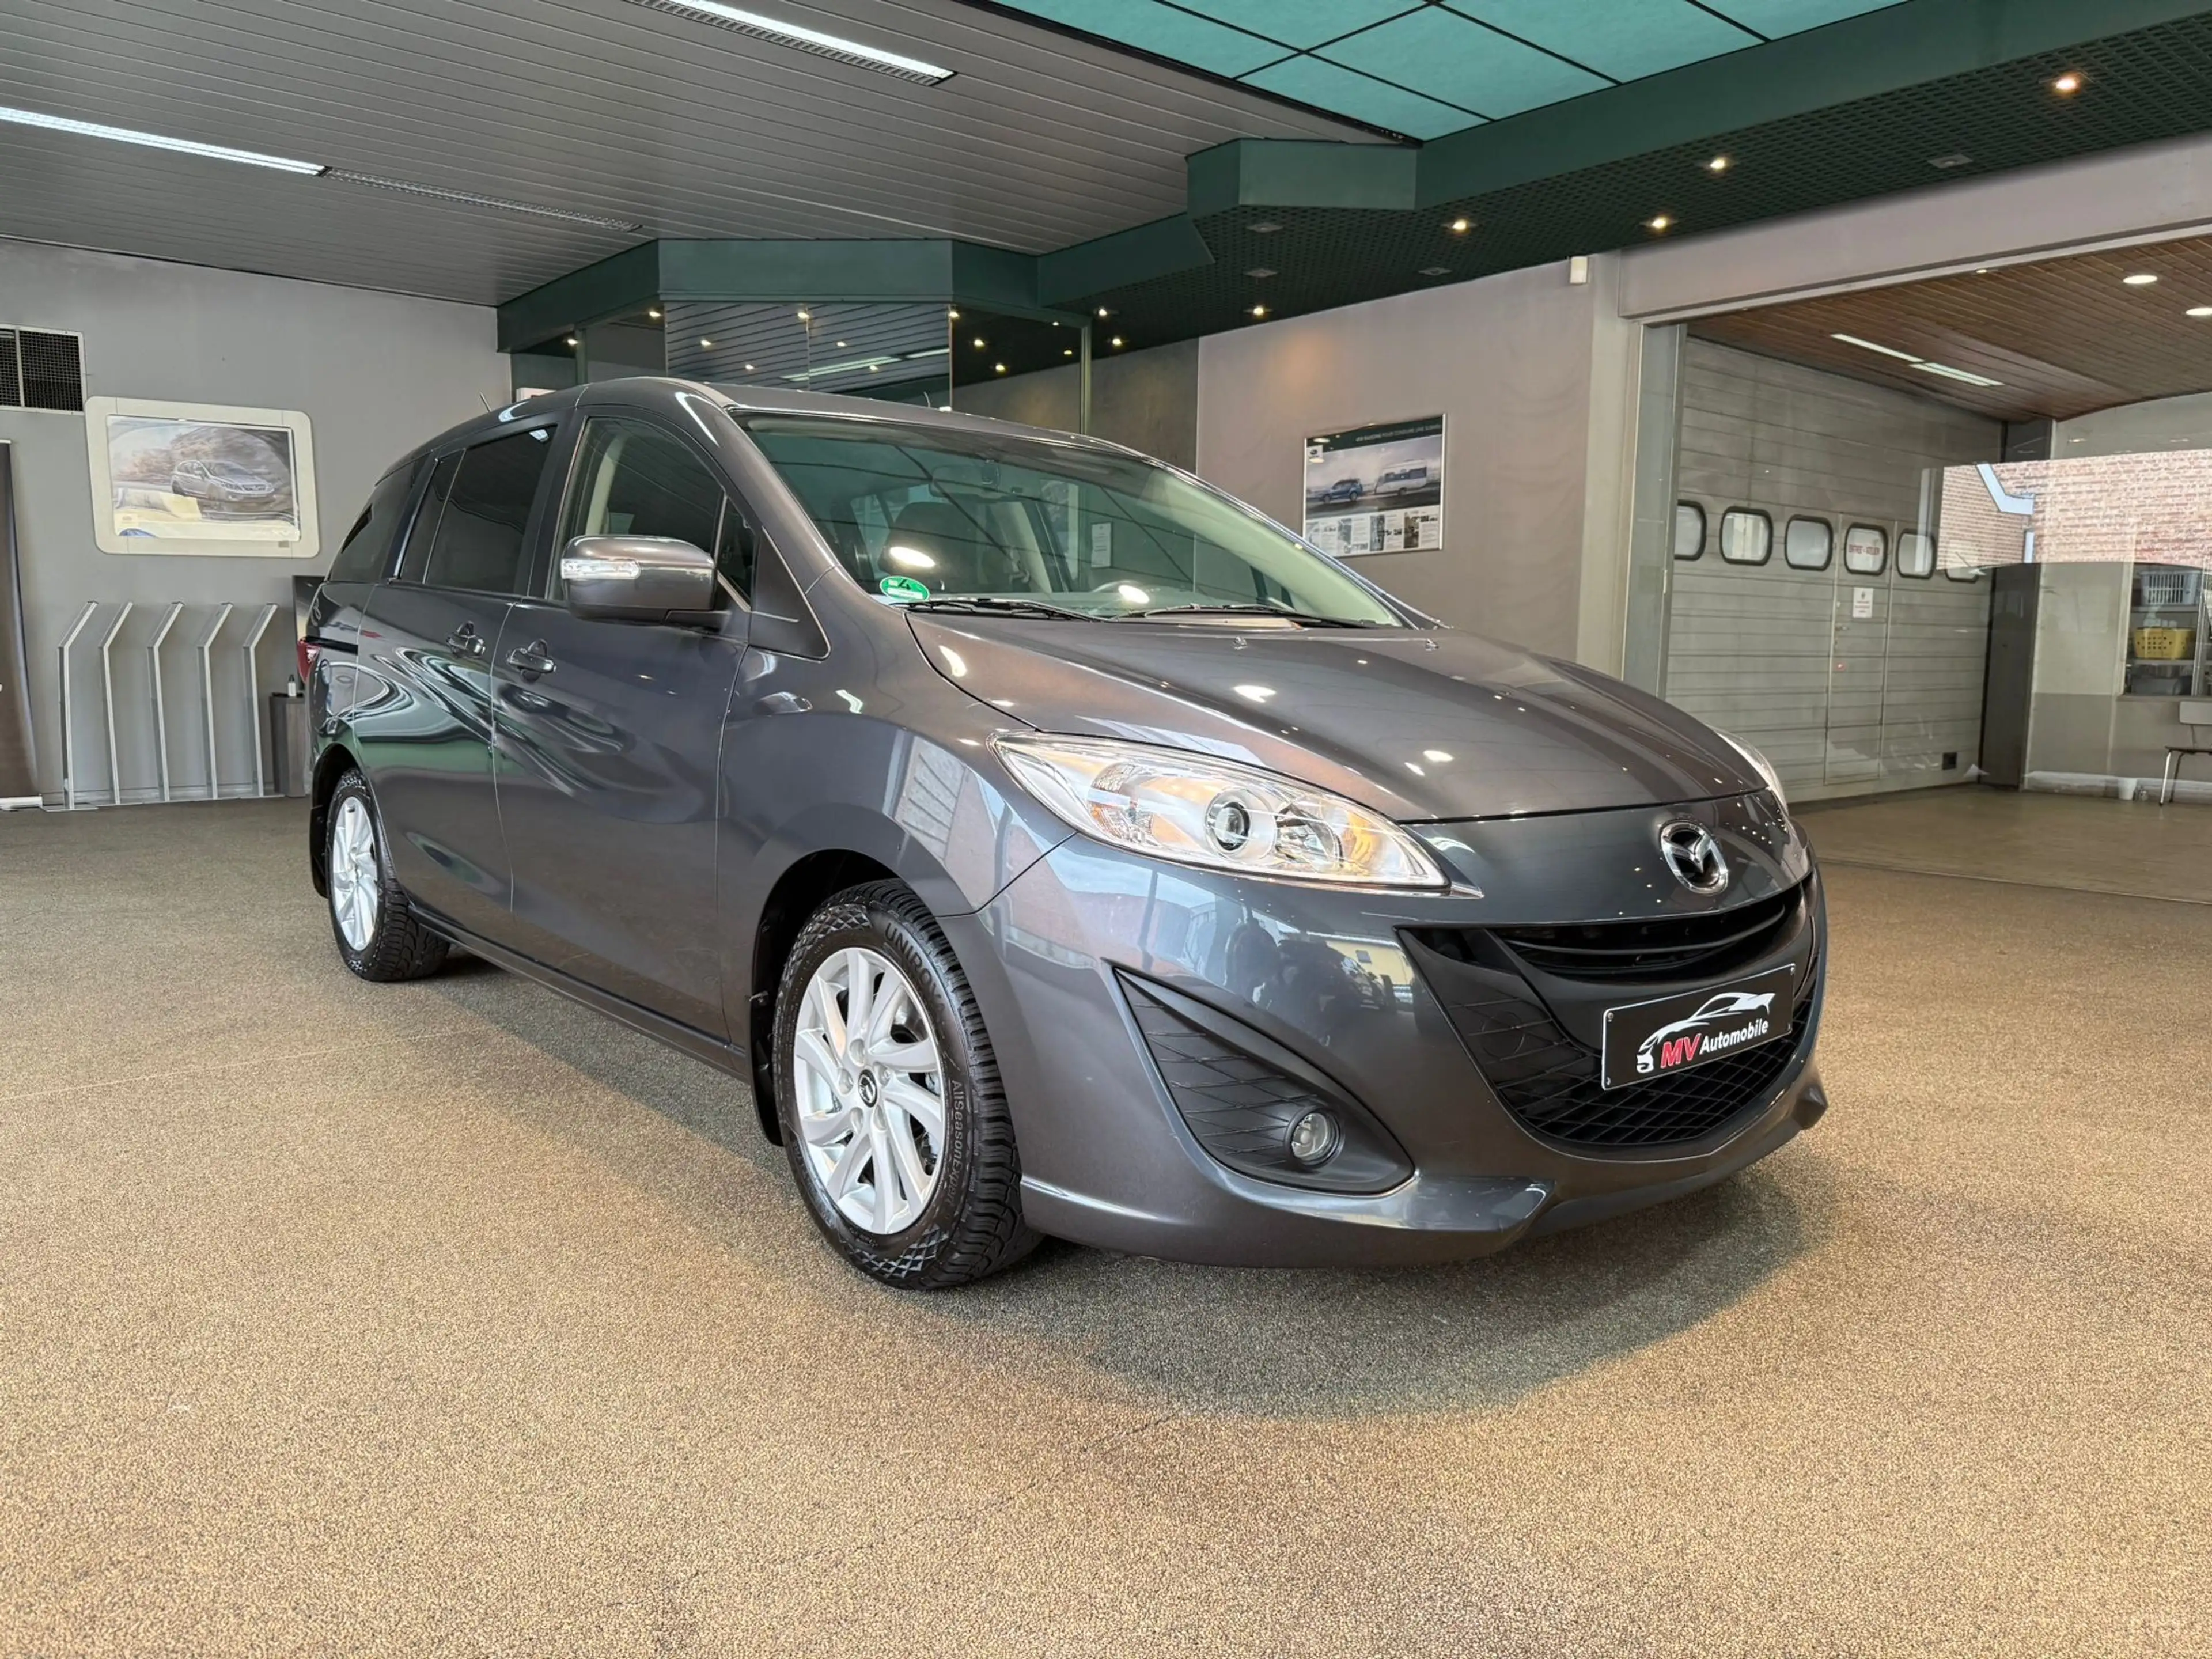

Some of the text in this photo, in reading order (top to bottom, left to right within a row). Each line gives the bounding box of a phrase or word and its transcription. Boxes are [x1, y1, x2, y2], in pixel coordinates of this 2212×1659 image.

[897, 579, 911, 590] 4
[885, 922, 945, 1018] UNIROYA
[1660, 1018, 1769, 1069] MV Automobile
